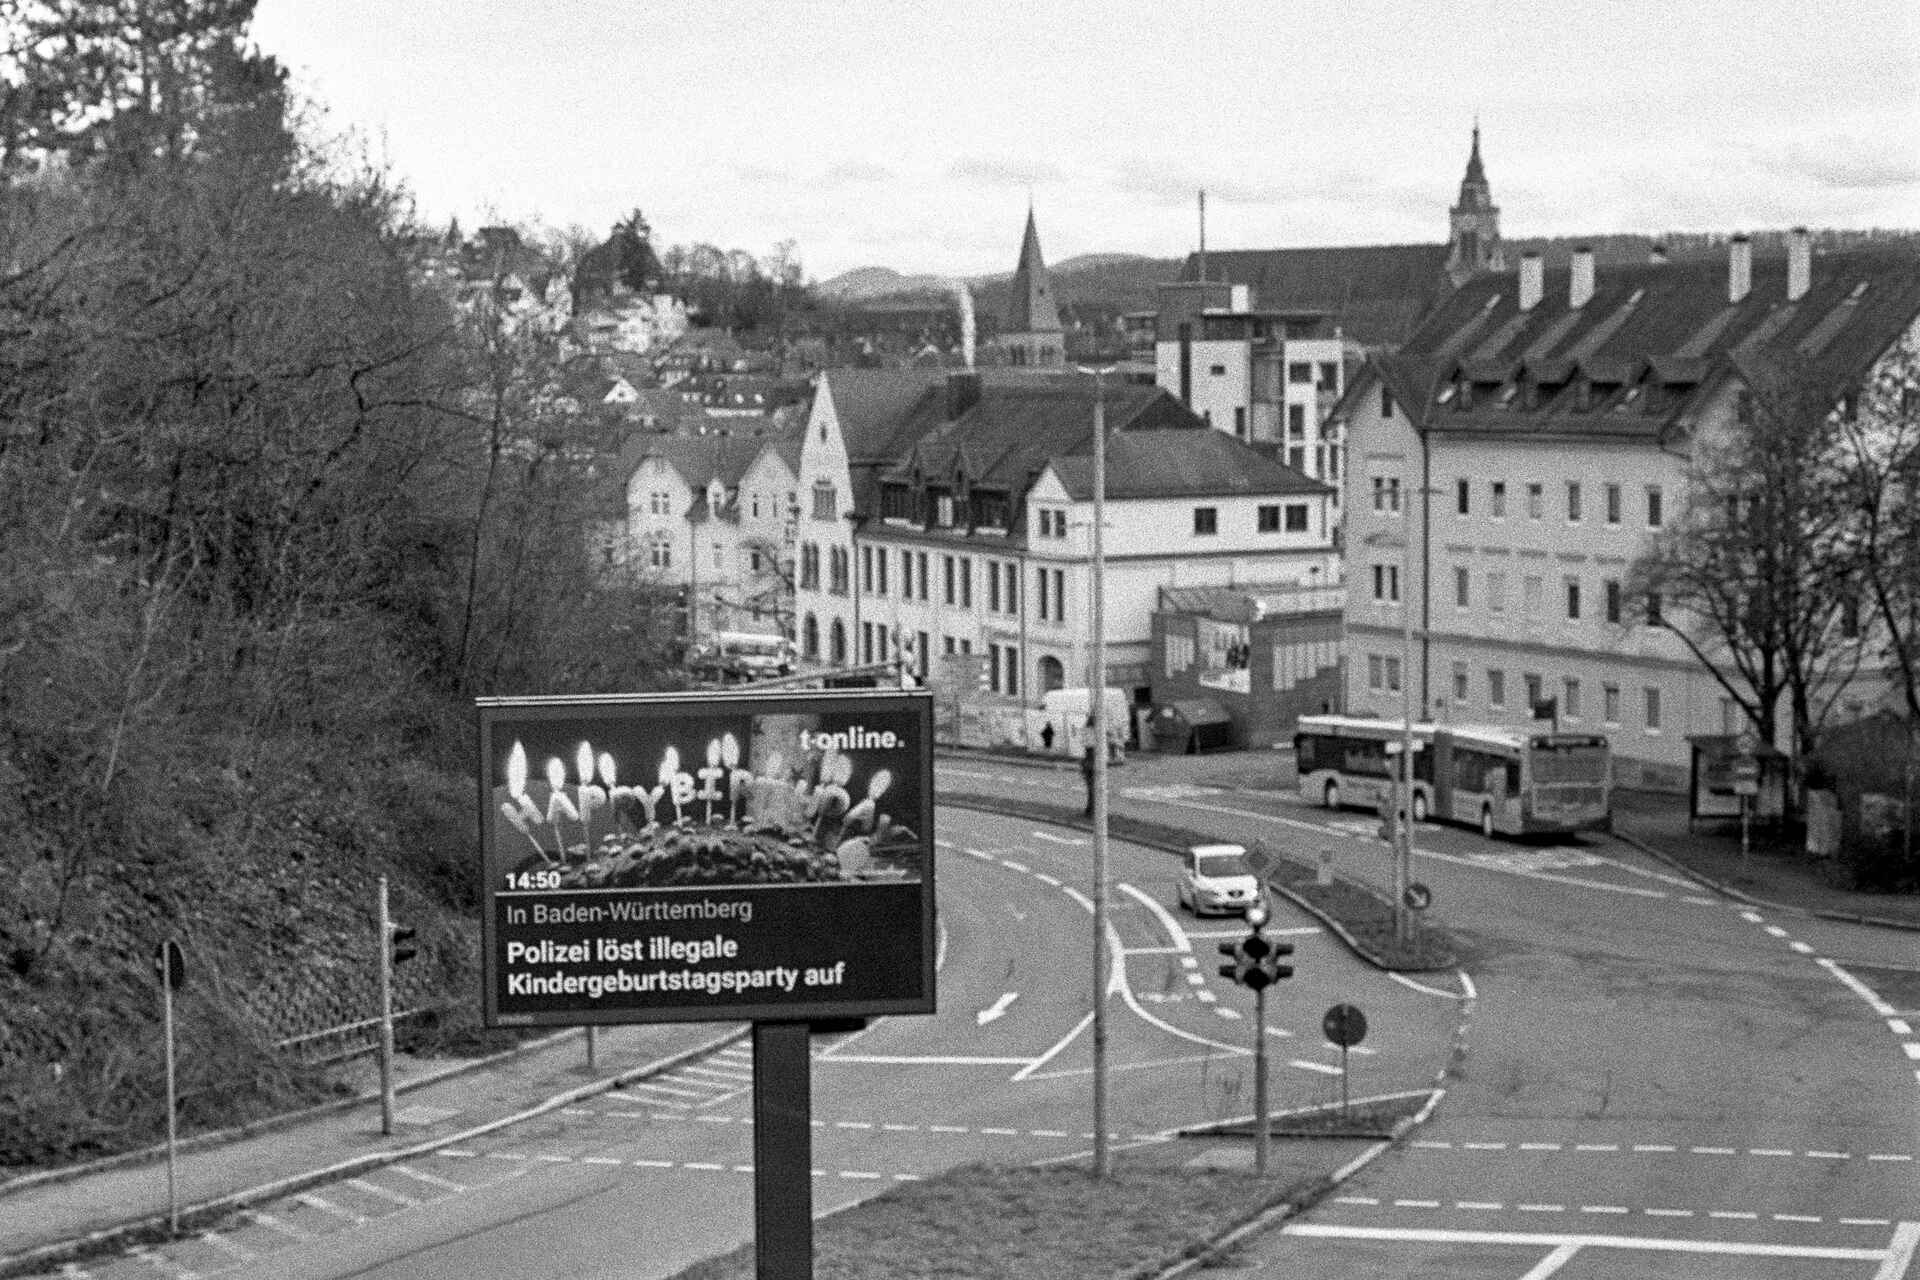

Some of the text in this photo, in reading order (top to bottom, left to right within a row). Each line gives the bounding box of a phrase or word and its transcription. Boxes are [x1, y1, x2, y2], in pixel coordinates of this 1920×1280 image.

[505, 871, 561, 890] 14:50
[507, 899, 753, 924] In Baden-Württemberg
[507, 934, 738, 964] Polizei löst illegale
[507, 961, 846, 995] Kindergeburtstagsparty auf
